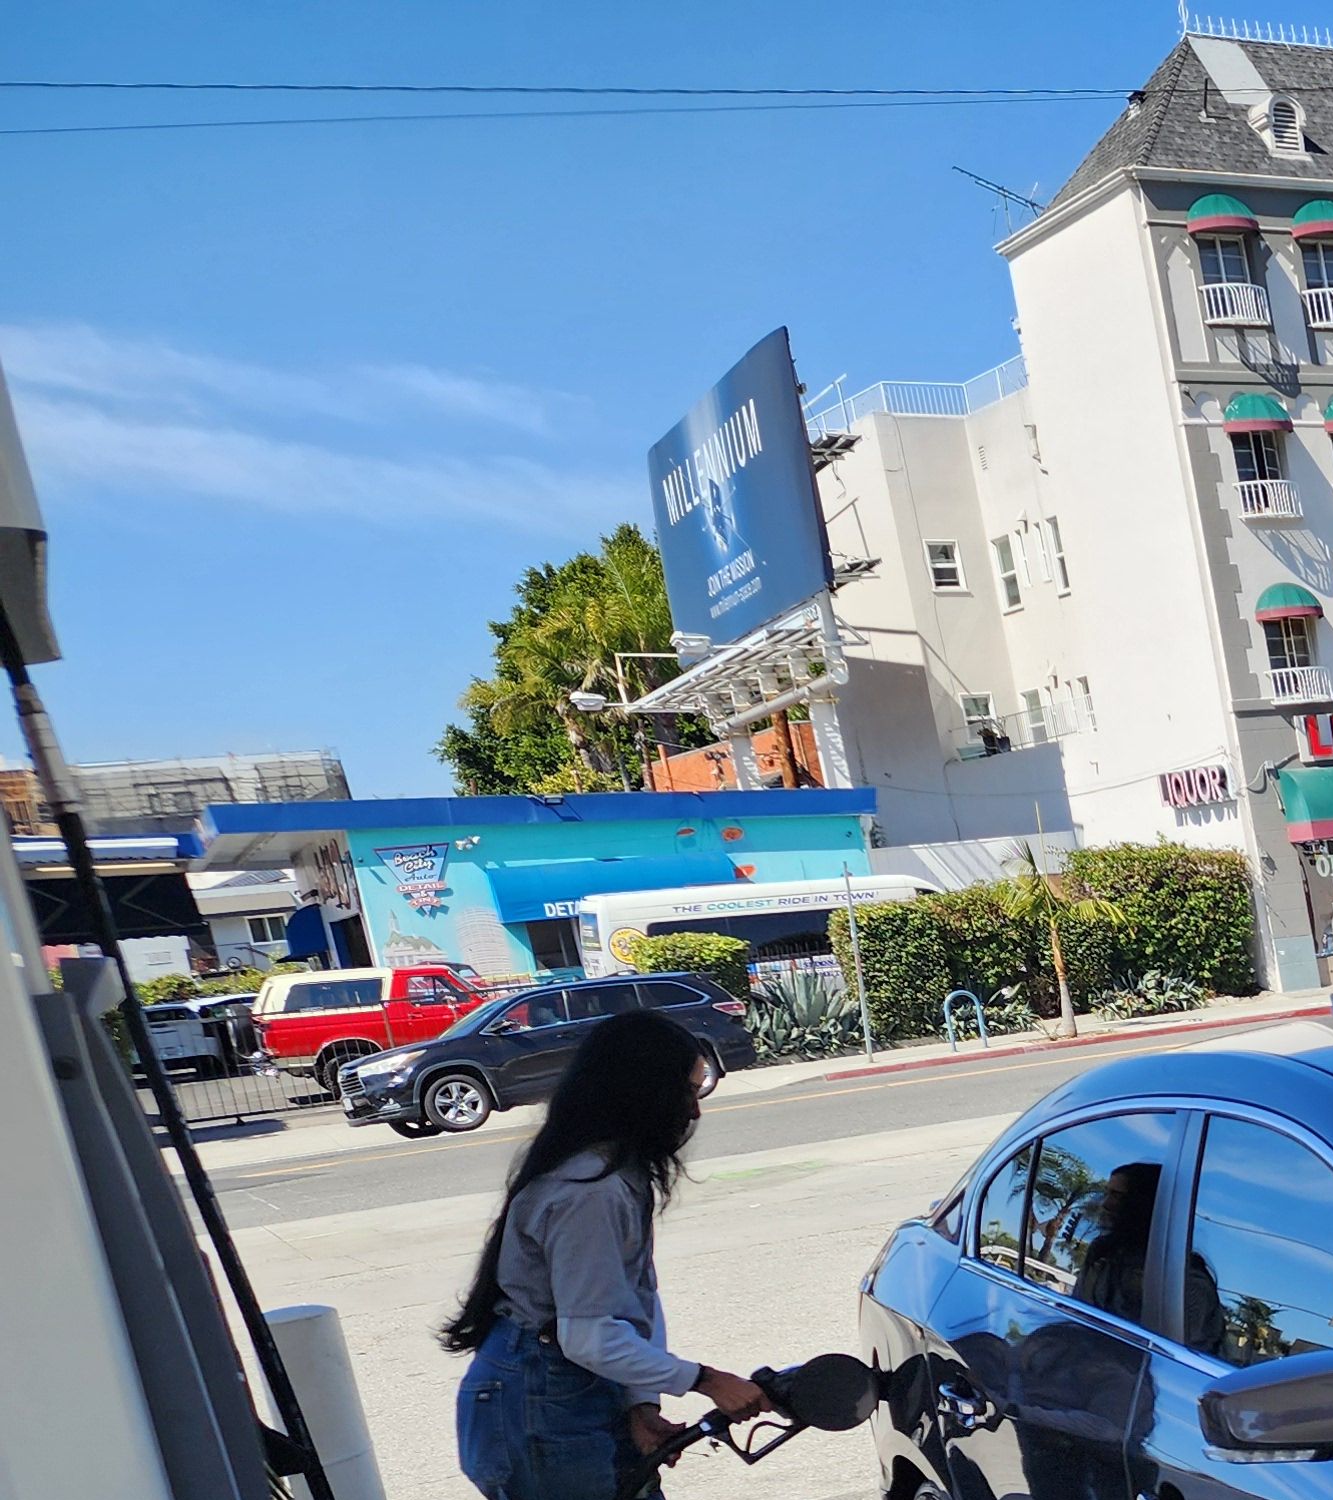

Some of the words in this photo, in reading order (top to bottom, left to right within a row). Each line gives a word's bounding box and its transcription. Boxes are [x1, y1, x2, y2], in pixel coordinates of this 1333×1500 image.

[662, 398, 762, 526] MILLENNIUM
[1157, 766, 1225, 808] LIQUOR
[394, 845, 435, 864] Beach
[404, 859, 433, 873] City
[405, 873, 436, 882] Auto
[399, 882, 444, 891] DETAIL
[420, 890, 428, 898] &
[673, 904, 702, 914] THE
[707, 899, 774, 911] COOLEST
[778, 895, 811, 906] RIDE
[815, 894, 828, 903] IN
